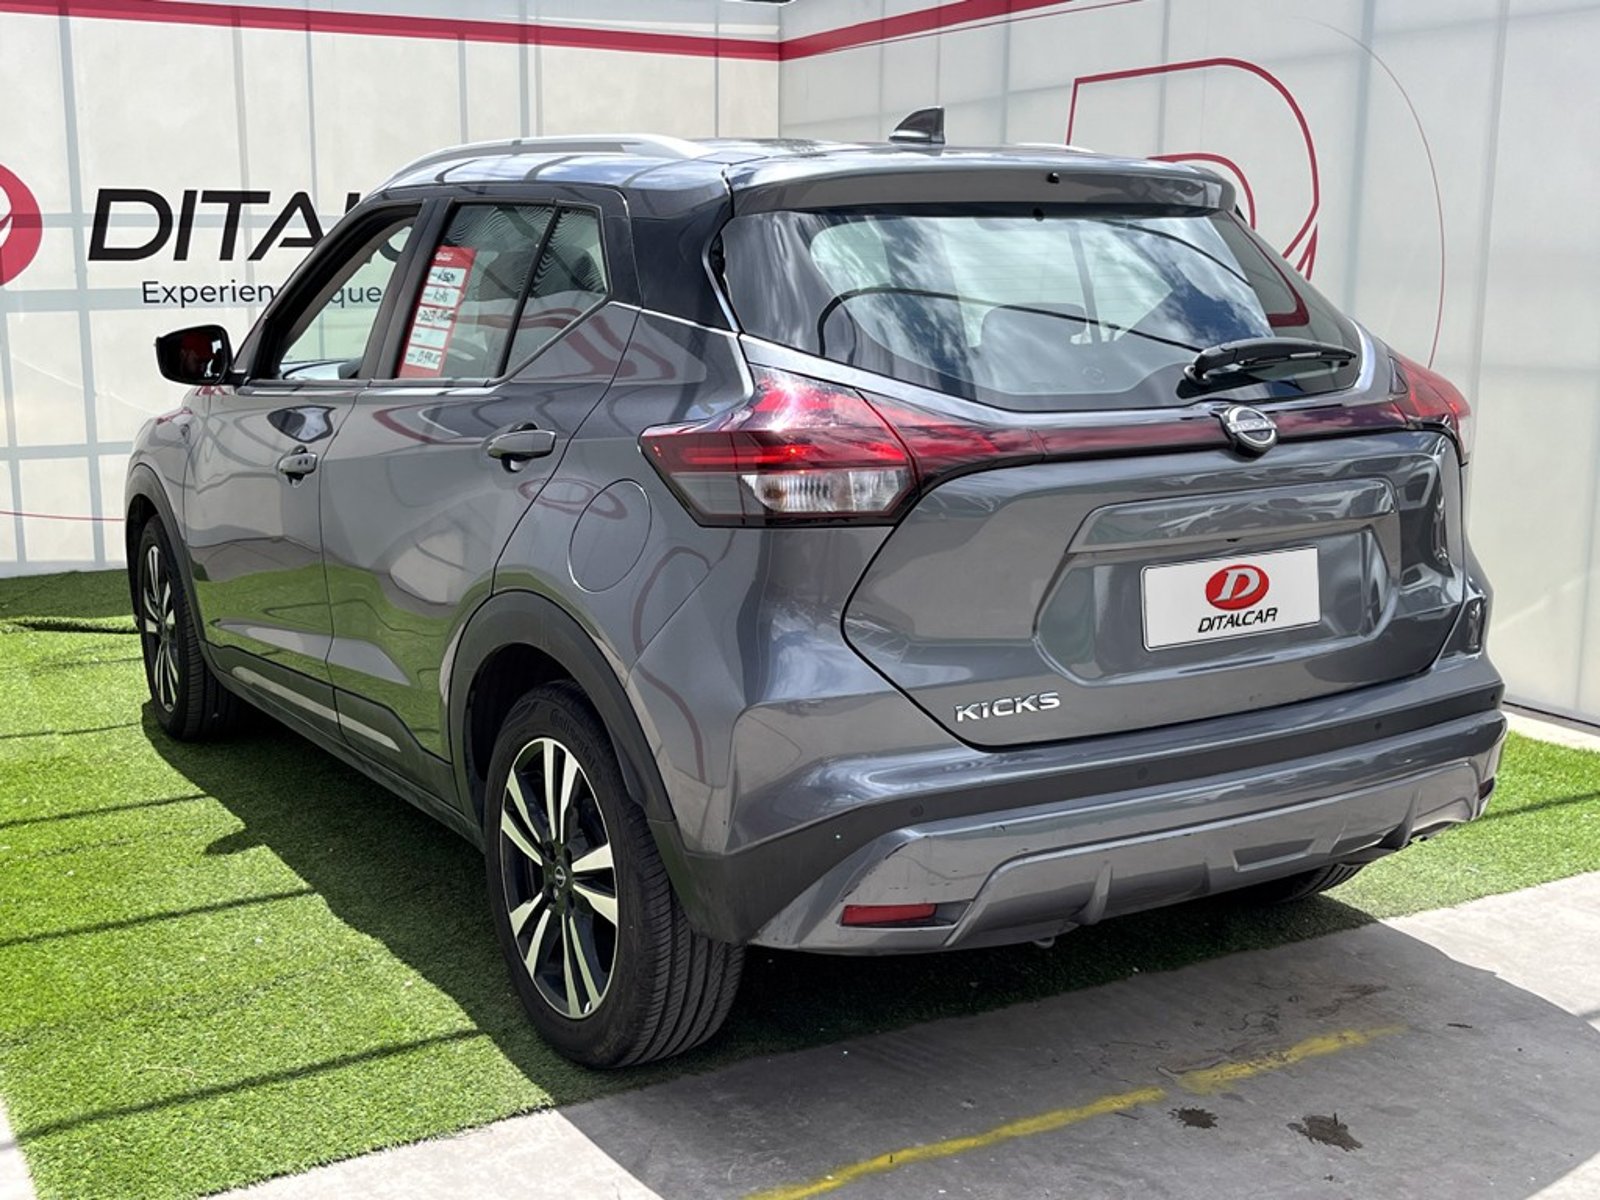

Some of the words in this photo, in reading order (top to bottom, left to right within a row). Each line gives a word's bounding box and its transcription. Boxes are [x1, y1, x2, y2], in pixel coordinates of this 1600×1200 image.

[142, 279, 277, 308] Experien
[1198, 606, 1278, 634] DITALCAR
[955, 691, 1061, 722] KICKS
